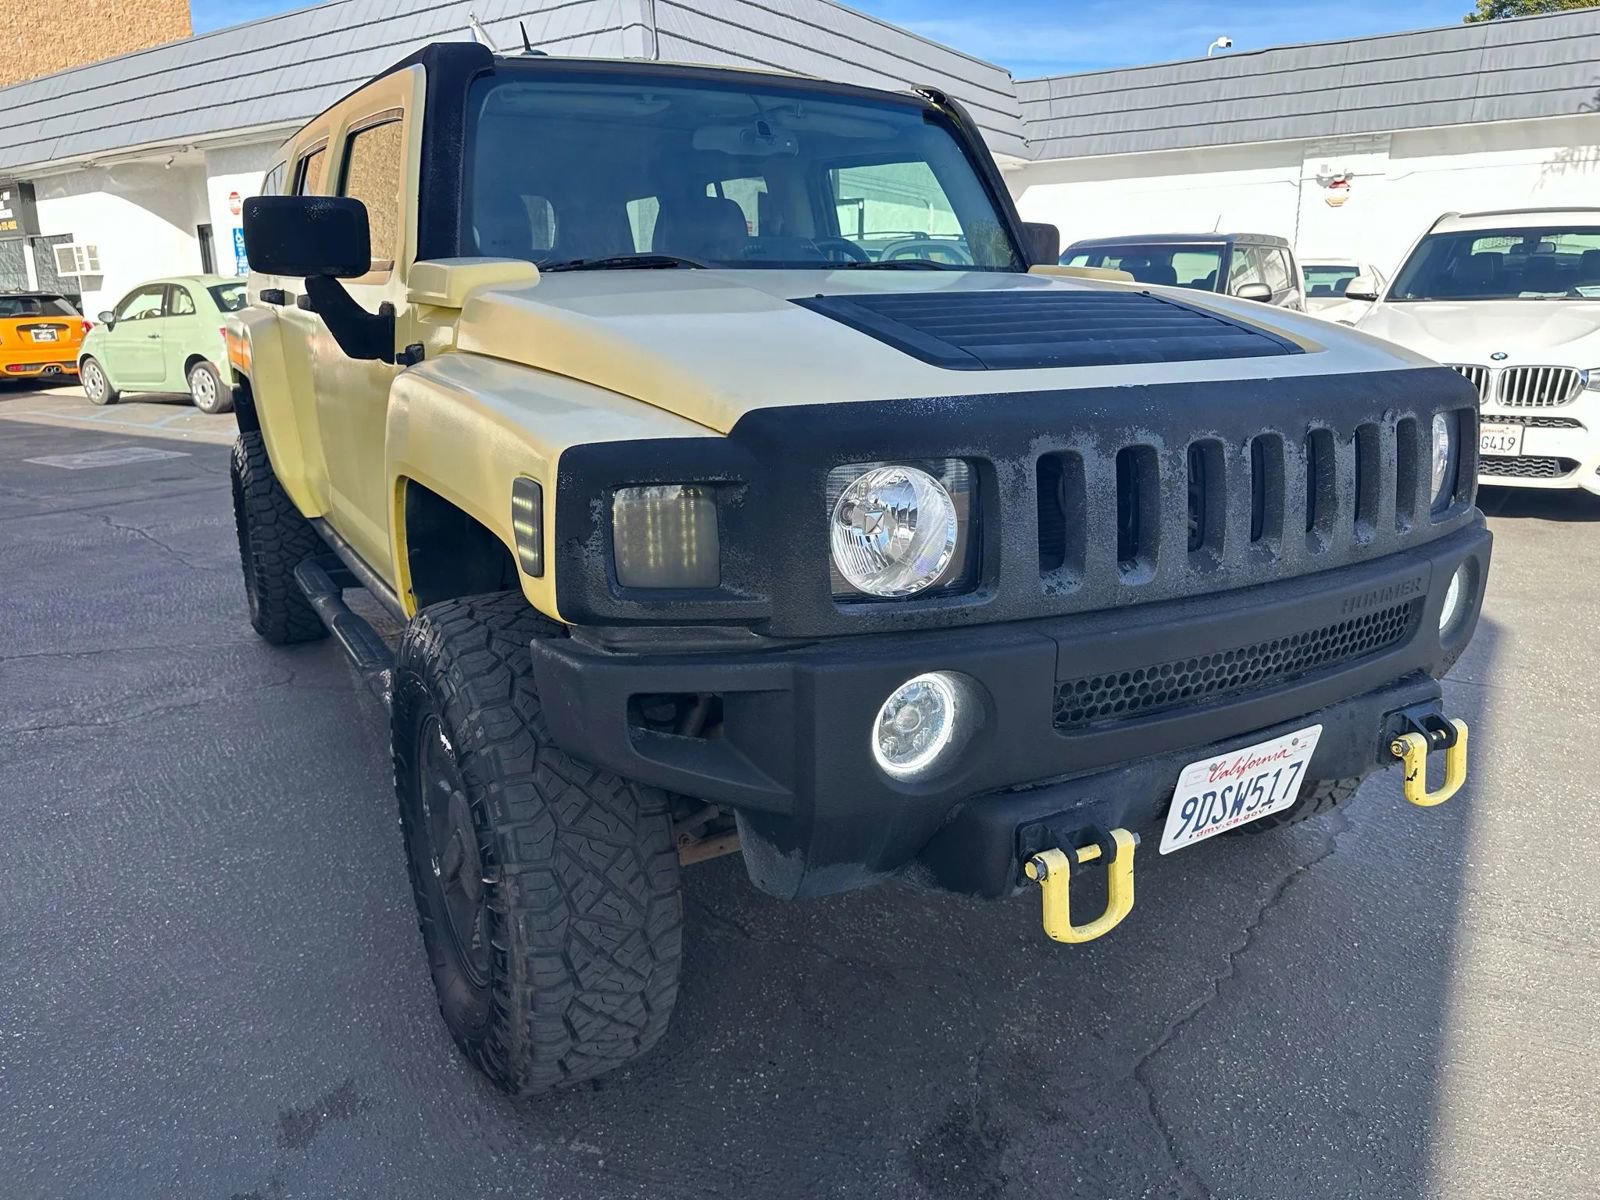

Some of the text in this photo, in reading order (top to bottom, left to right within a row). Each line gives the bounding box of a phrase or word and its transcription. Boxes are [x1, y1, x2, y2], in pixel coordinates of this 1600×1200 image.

[1341, 577, 1422, 614] HUMMER
[1208, 745, 1293, 784] California
[1173, 760, 1303, 840] 9DSW517
[1196, 807, 1266, 838] dmv.ca.gov
